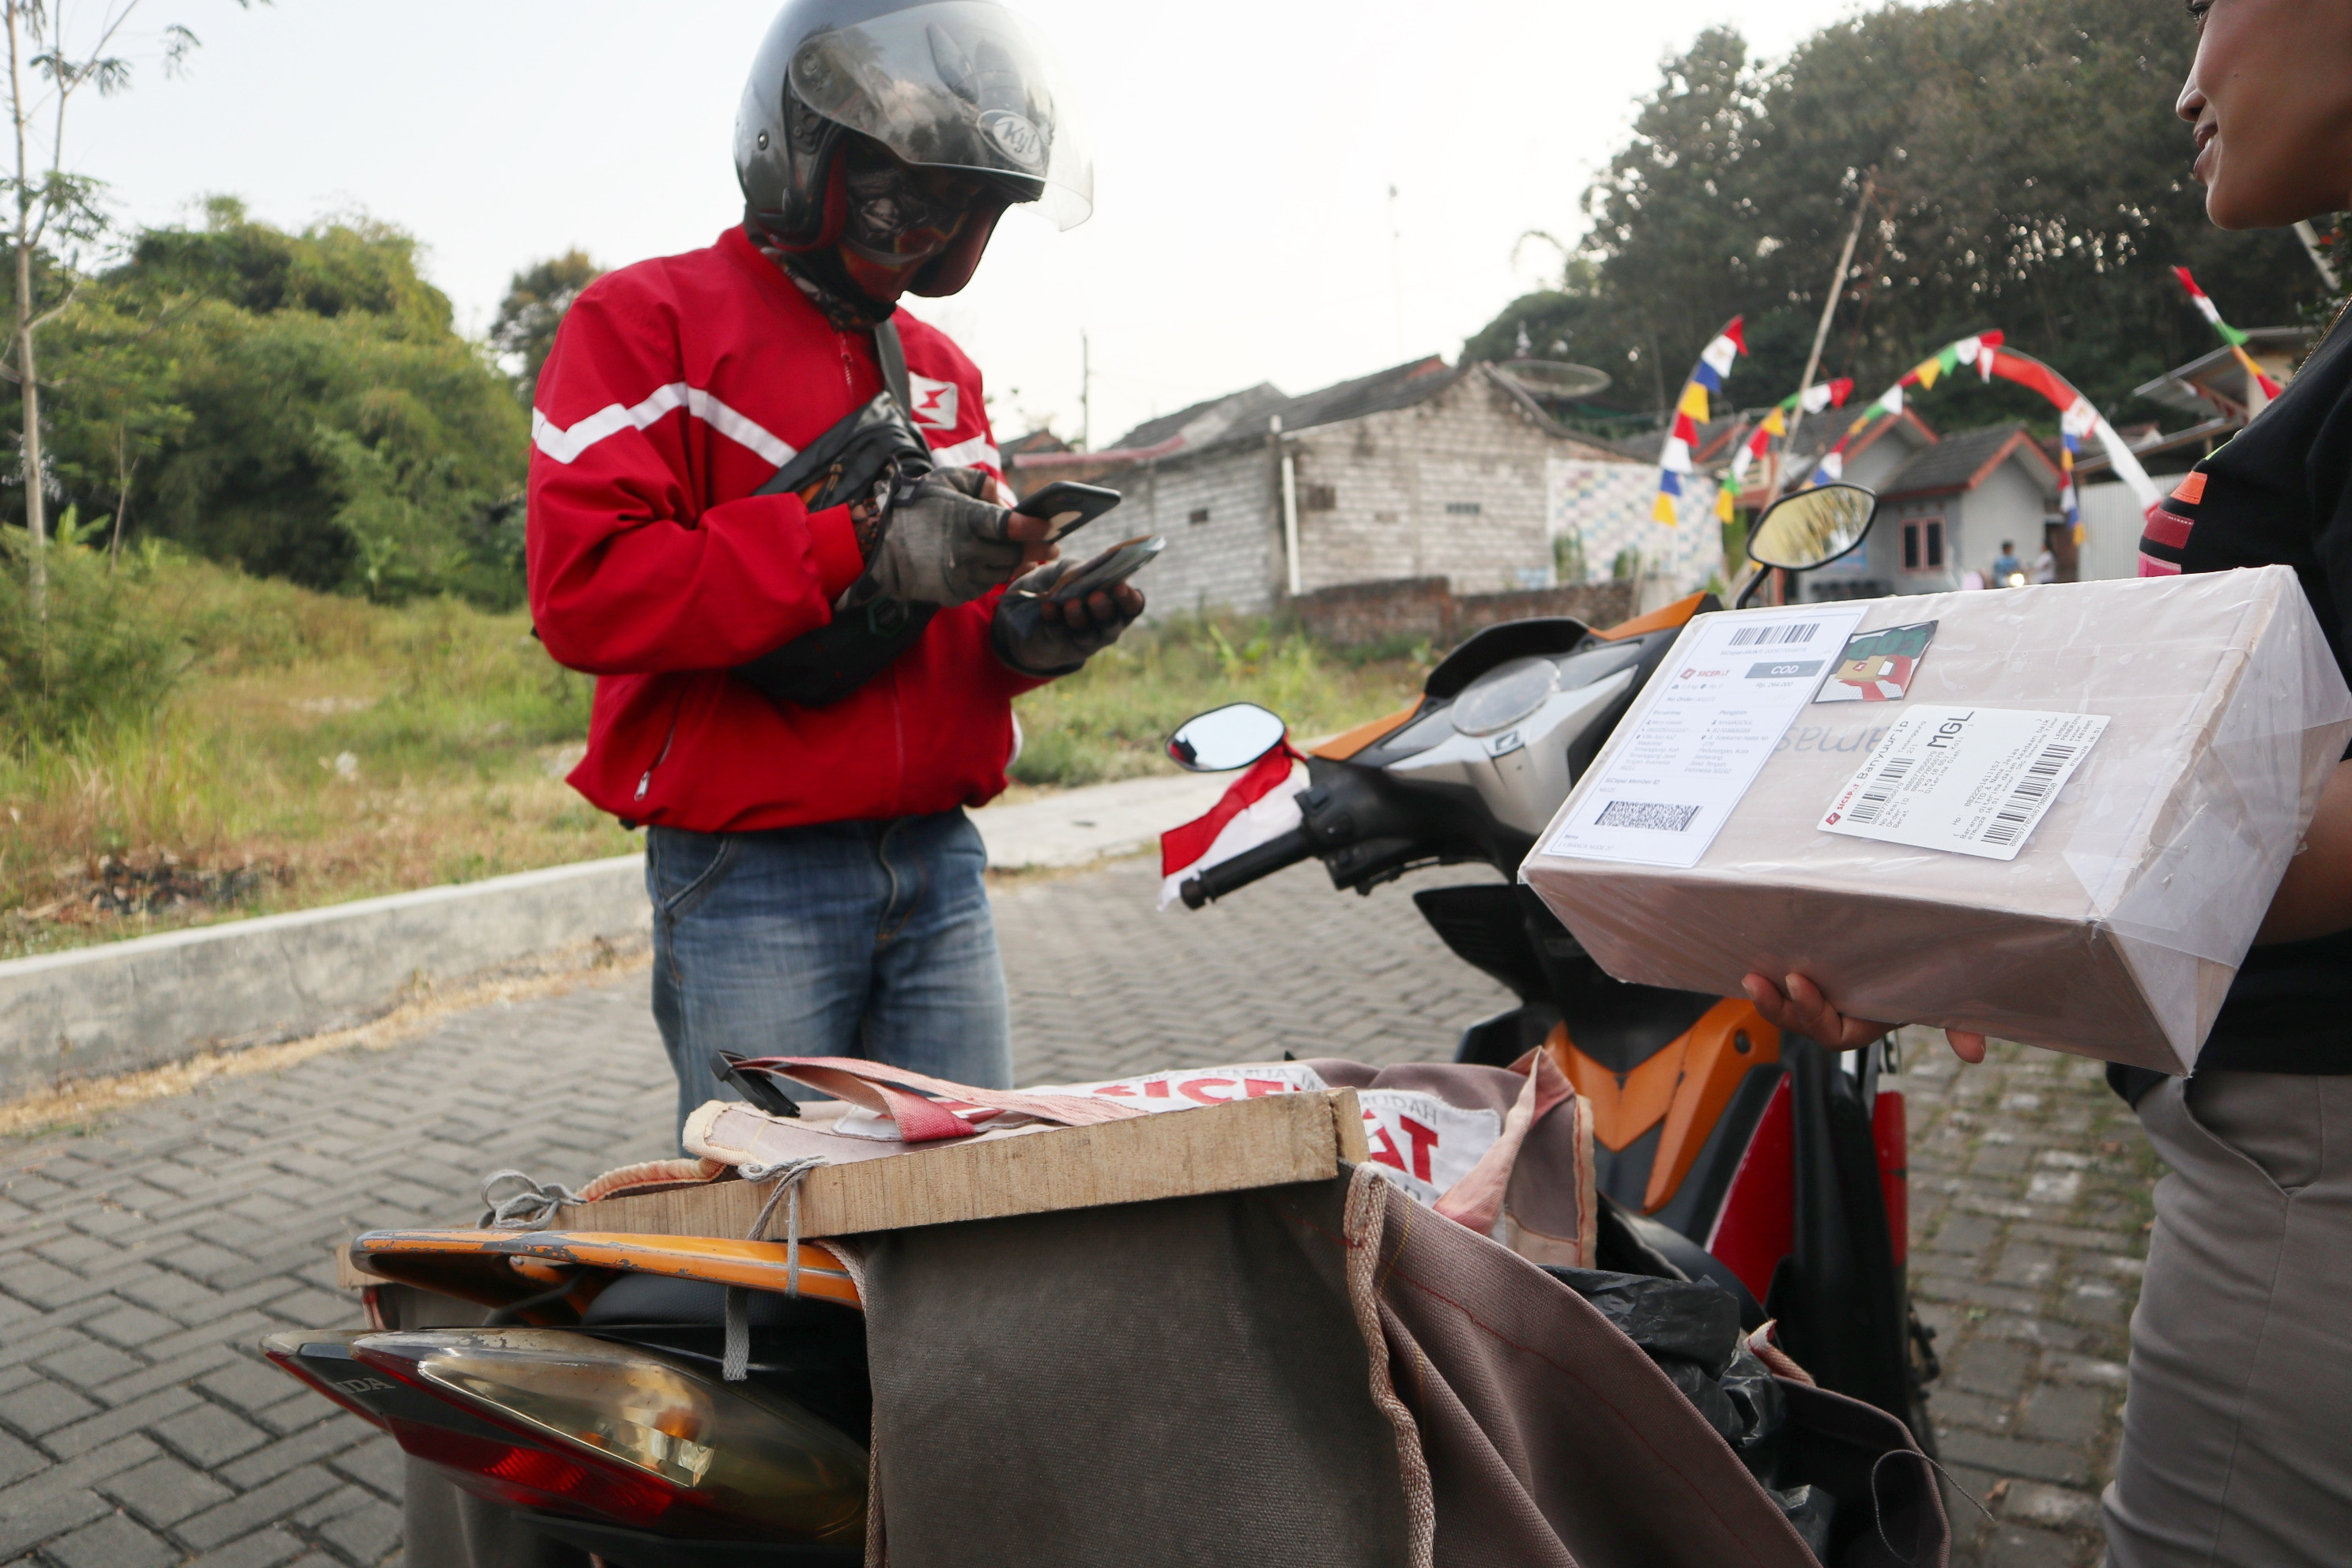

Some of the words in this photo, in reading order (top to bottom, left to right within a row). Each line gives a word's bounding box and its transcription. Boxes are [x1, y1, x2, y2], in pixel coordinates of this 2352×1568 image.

[1845, 628, 1928, 662] COD
[1771, 665, 1800, 675] COD
[1927, 711, 1974, 748] MGL
[1856, 721, 1909, 779] Banyuurip
[1959, 816, 1981, 839] Barang
[1978, 783, 2002, 813] diterima
[2015, 735, 2037, 760] keadaan
[2035, 719, 2050, 733] baik
[1886, 808, 1901, 827] Order
